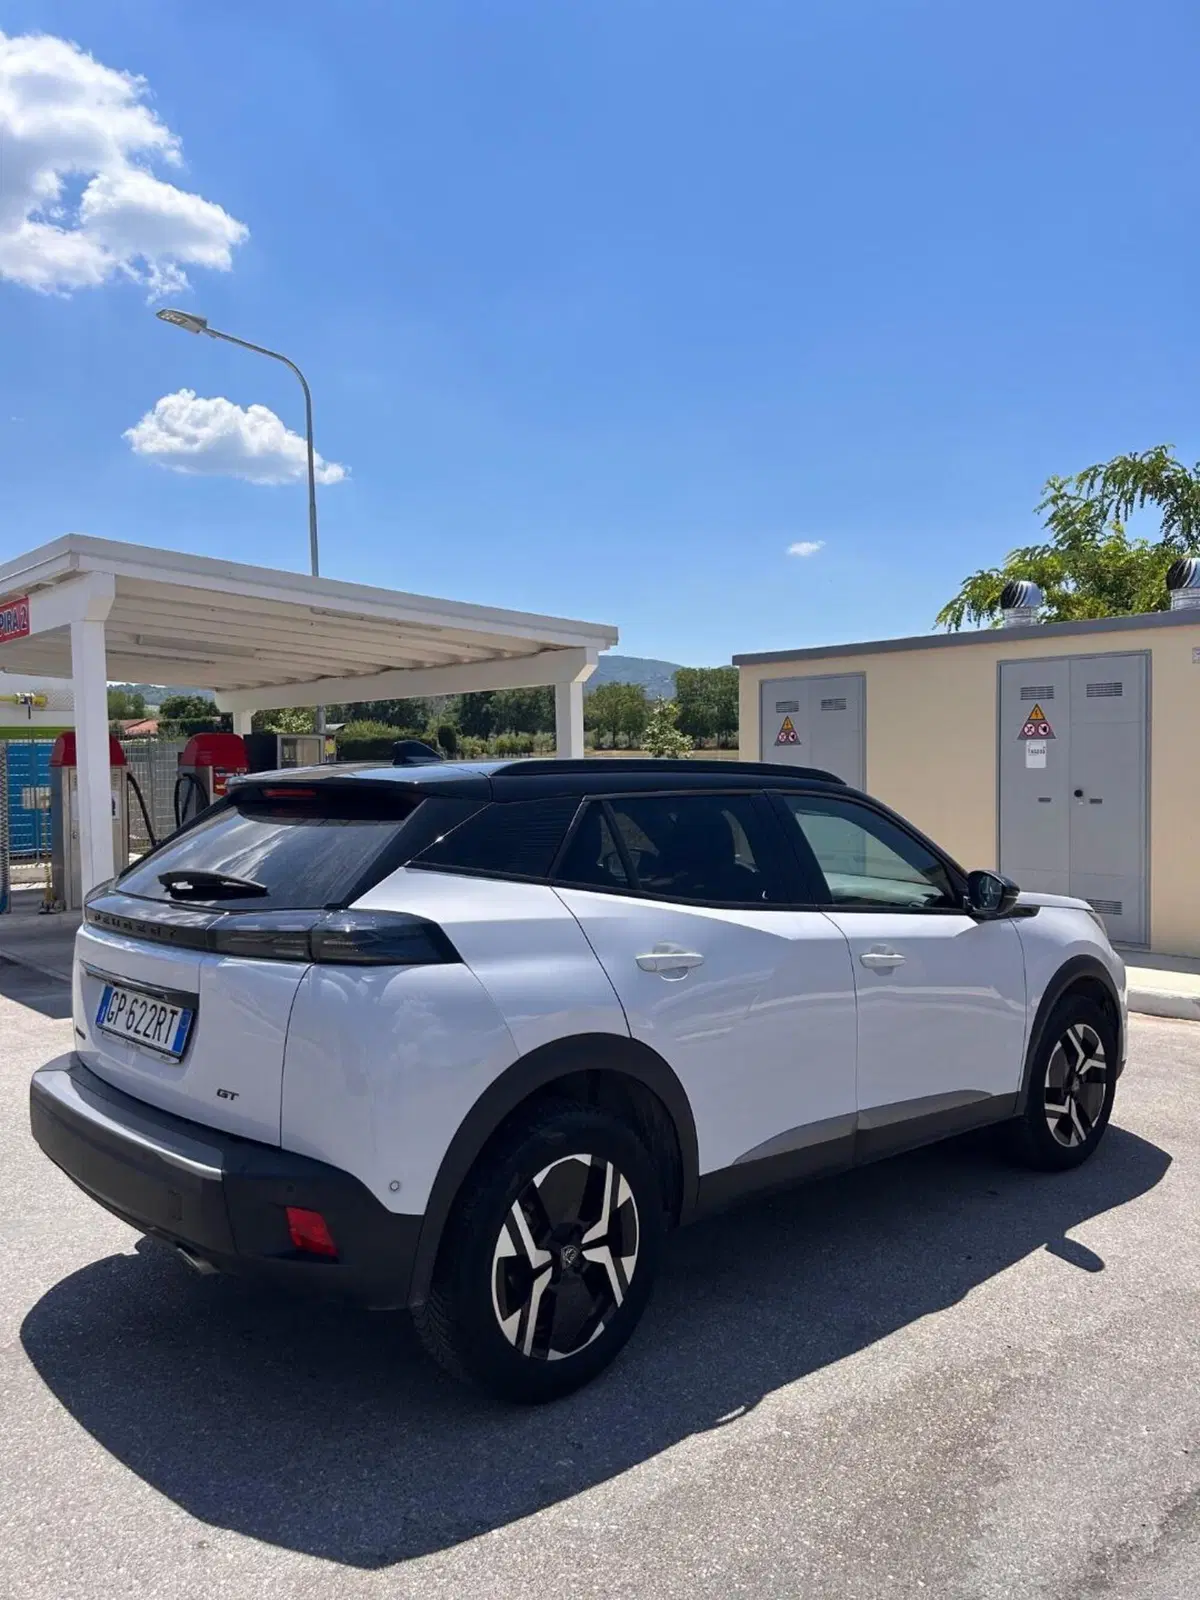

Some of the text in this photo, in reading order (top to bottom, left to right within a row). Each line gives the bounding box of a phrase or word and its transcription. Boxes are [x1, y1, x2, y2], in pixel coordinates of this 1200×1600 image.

[20, 604, 28, 630] 2
[126, 998, 179, 1044] 622RT
[216, 1088, 240, 1101] GT
